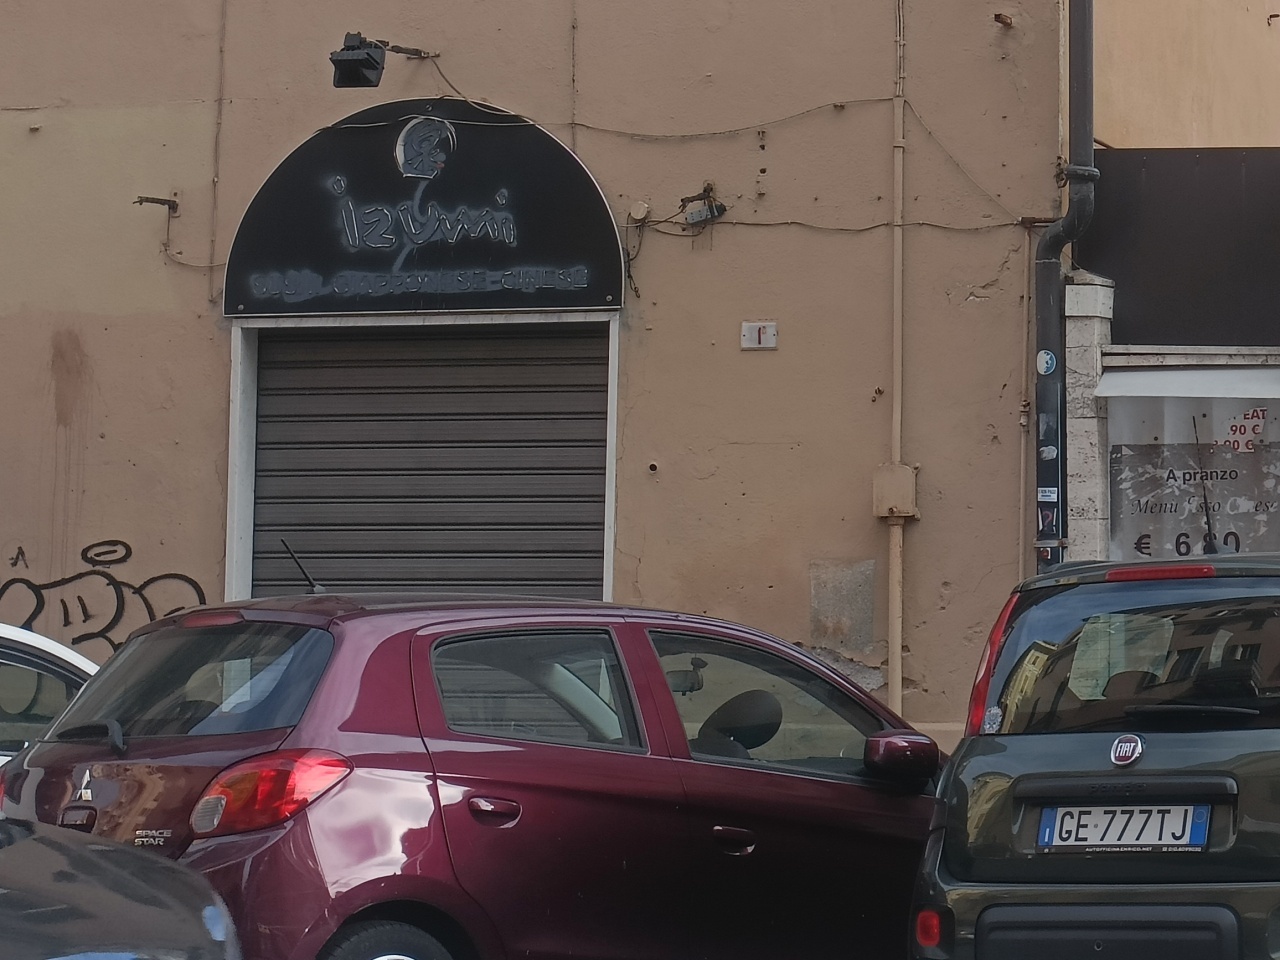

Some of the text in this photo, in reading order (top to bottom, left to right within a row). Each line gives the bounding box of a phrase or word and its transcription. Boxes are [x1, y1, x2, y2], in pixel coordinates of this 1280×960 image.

[1165, 469, 1239, 485] A pranzo
[1116, 742, 1136, 757] FIAT
[1058, 810, 1092, 842] GE
[1099, 808, 1189, 842] 777TJ
[135, 829, 172, 837] SPACE
[134, 837, 165, 846] STAR
